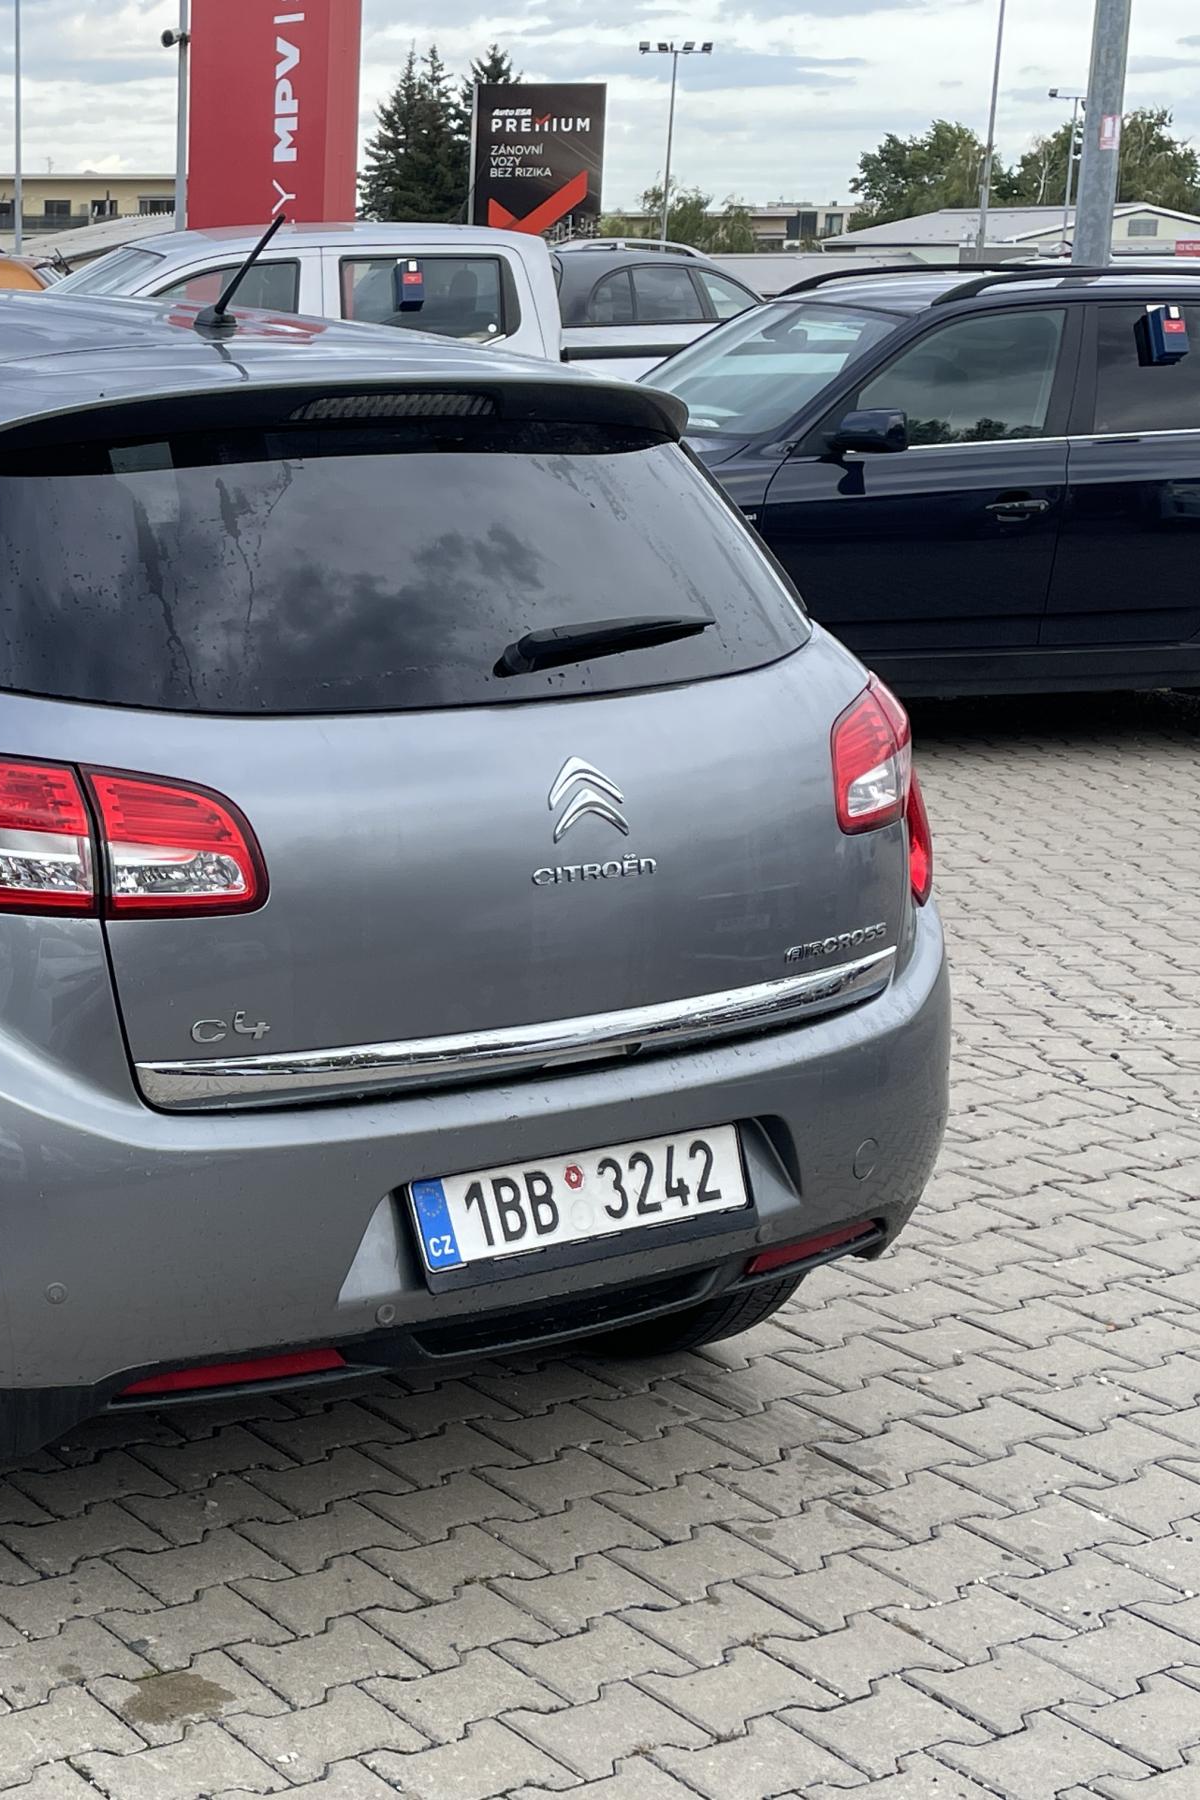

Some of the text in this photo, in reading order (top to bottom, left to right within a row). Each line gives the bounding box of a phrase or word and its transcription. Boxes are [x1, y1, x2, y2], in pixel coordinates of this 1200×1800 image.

[273, 36, 300, 162] MPV
[515, 108, 532, 116] ESA
[491, 115, 590, 132] PREMIUM
[490, 143, 543, 155] ZÁNOVNÍ
[490, 157, 522, 166] VOZY
[490, 167, 552, 177] BEZ RIZIKA
[784, 922, 887, 963] AIRCROSS
[191, 1010, 271, 1043] C4
[464, 1139, 722, 1247] 1BB 3242
[428, 1234, 455, 1258] CZ
